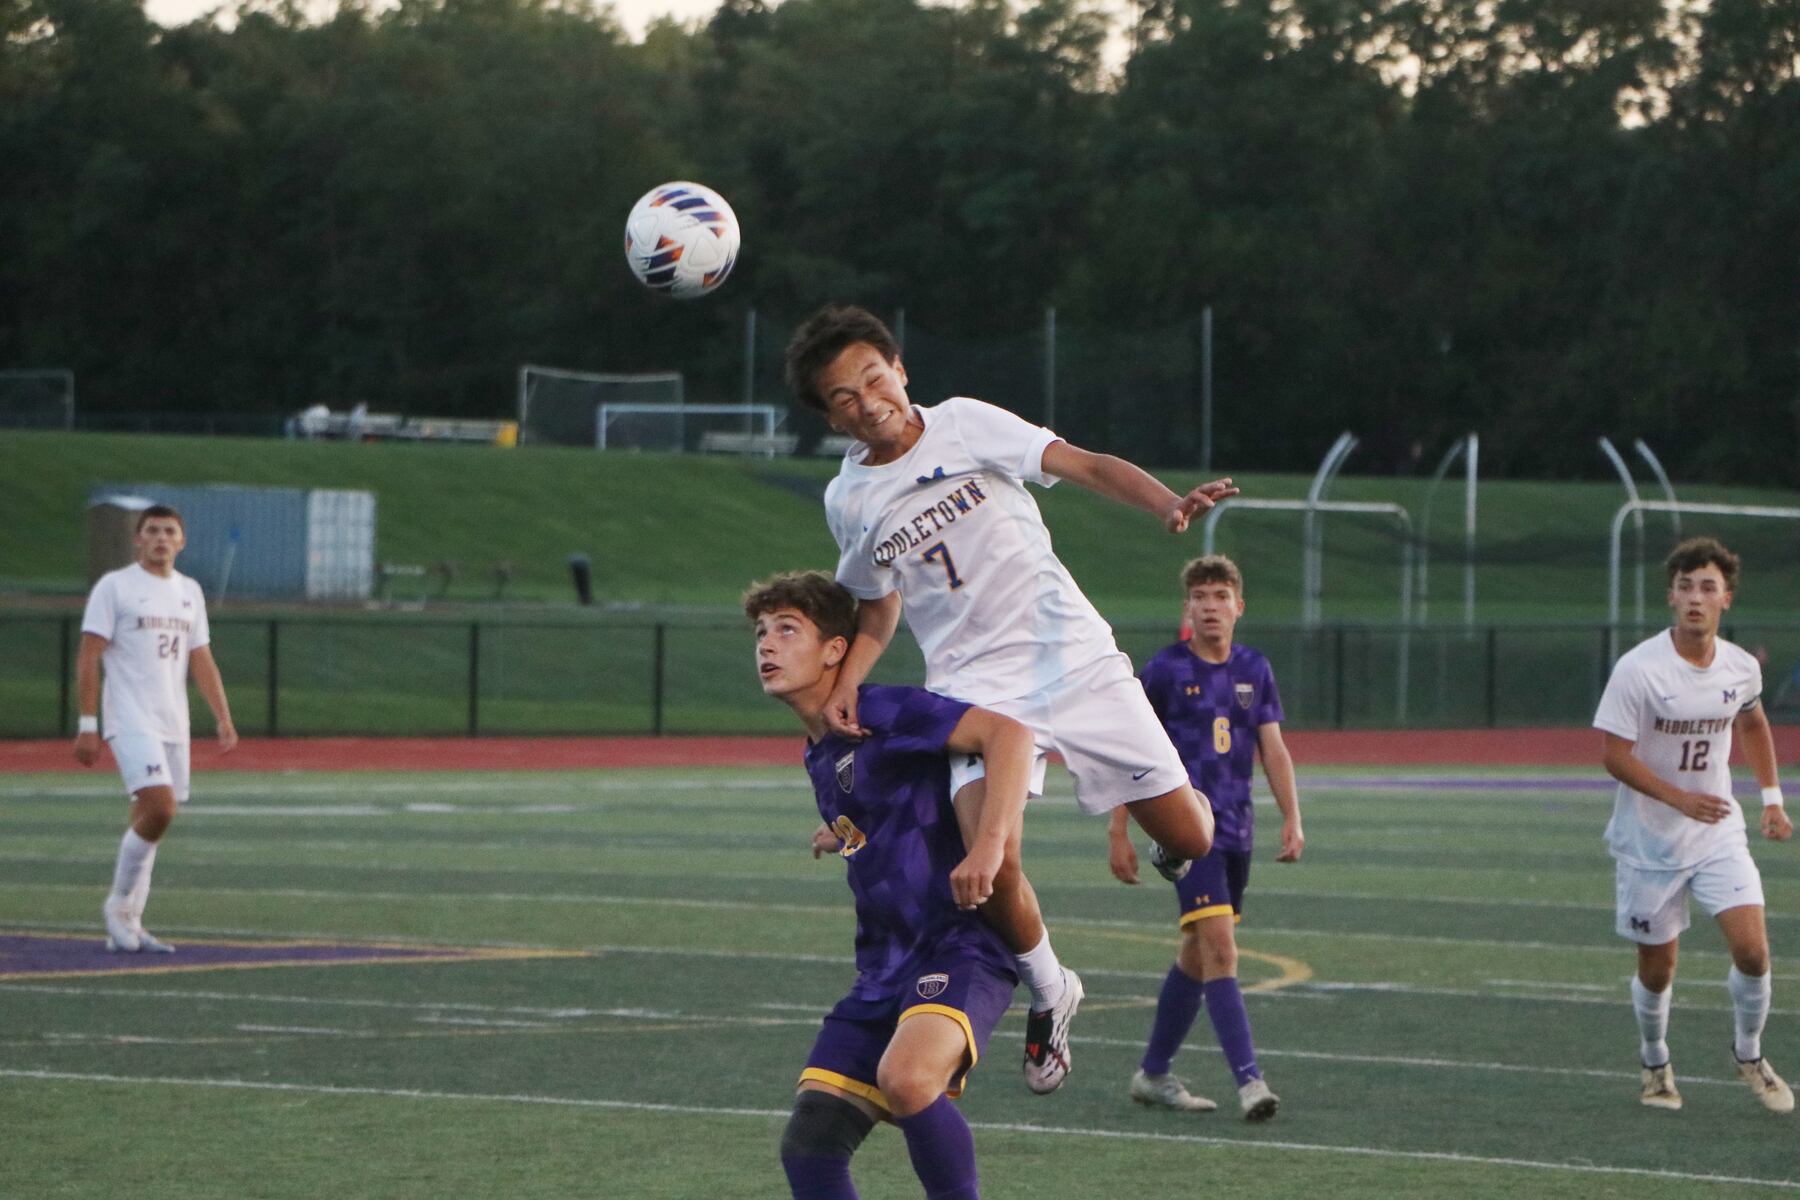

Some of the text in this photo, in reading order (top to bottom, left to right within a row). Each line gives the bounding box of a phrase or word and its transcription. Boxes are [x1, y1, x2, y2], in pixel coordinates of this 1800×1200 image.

[873, 480, 986, 568] DDLETOWN
[922, 541, 964, 592] 7
[158, 634, 179, 661] 24
[1722, 689, 1737, 704] M
[1213, 716, 1231, 754] 6
[1678, 740, 1710, 771] 12
[1630, 916, 1650, 934] M
